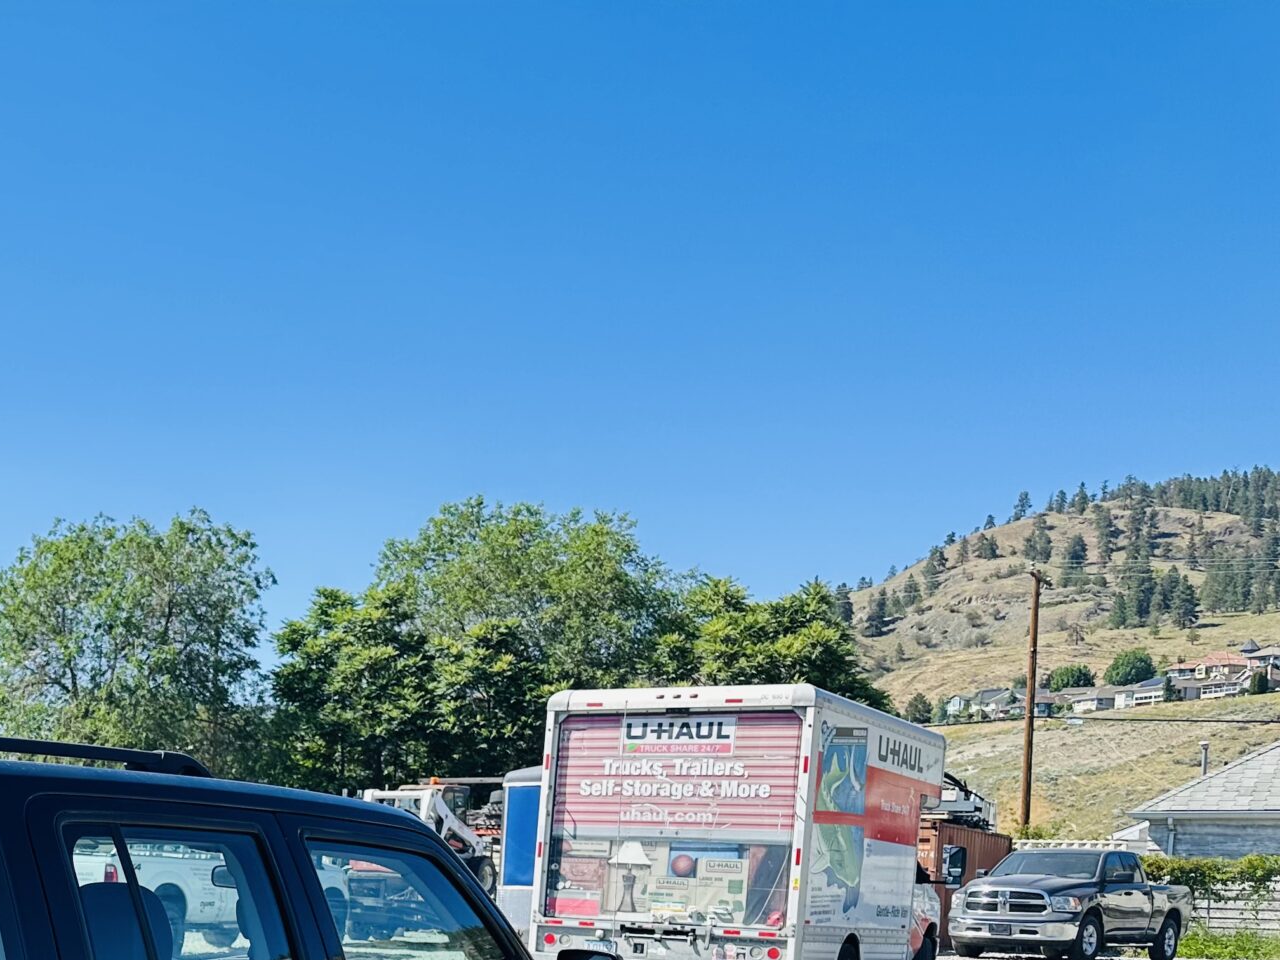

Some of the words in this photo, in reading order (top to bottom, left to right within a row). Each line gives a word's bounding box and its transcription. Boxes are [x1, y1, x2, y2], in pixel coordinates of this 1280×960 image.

[625, 721, 731, 740] U-HAUL
[639, 744, 667, 753] TRUCK
[669, 744, 699, 753] SHARE
[700, 744, 720, 753] 24/7
[878, 734, 924, 774] U-HAUL
[602, 758, 667, 778] Trucks,
[672, 758, 749, 779] Trailers,
[579, 778, 694, 799] Self-Storage
[699, 780, 714, 797] &
[719, 780, 771, 799] More
[620, 807, 714, 823] uhaul.com
